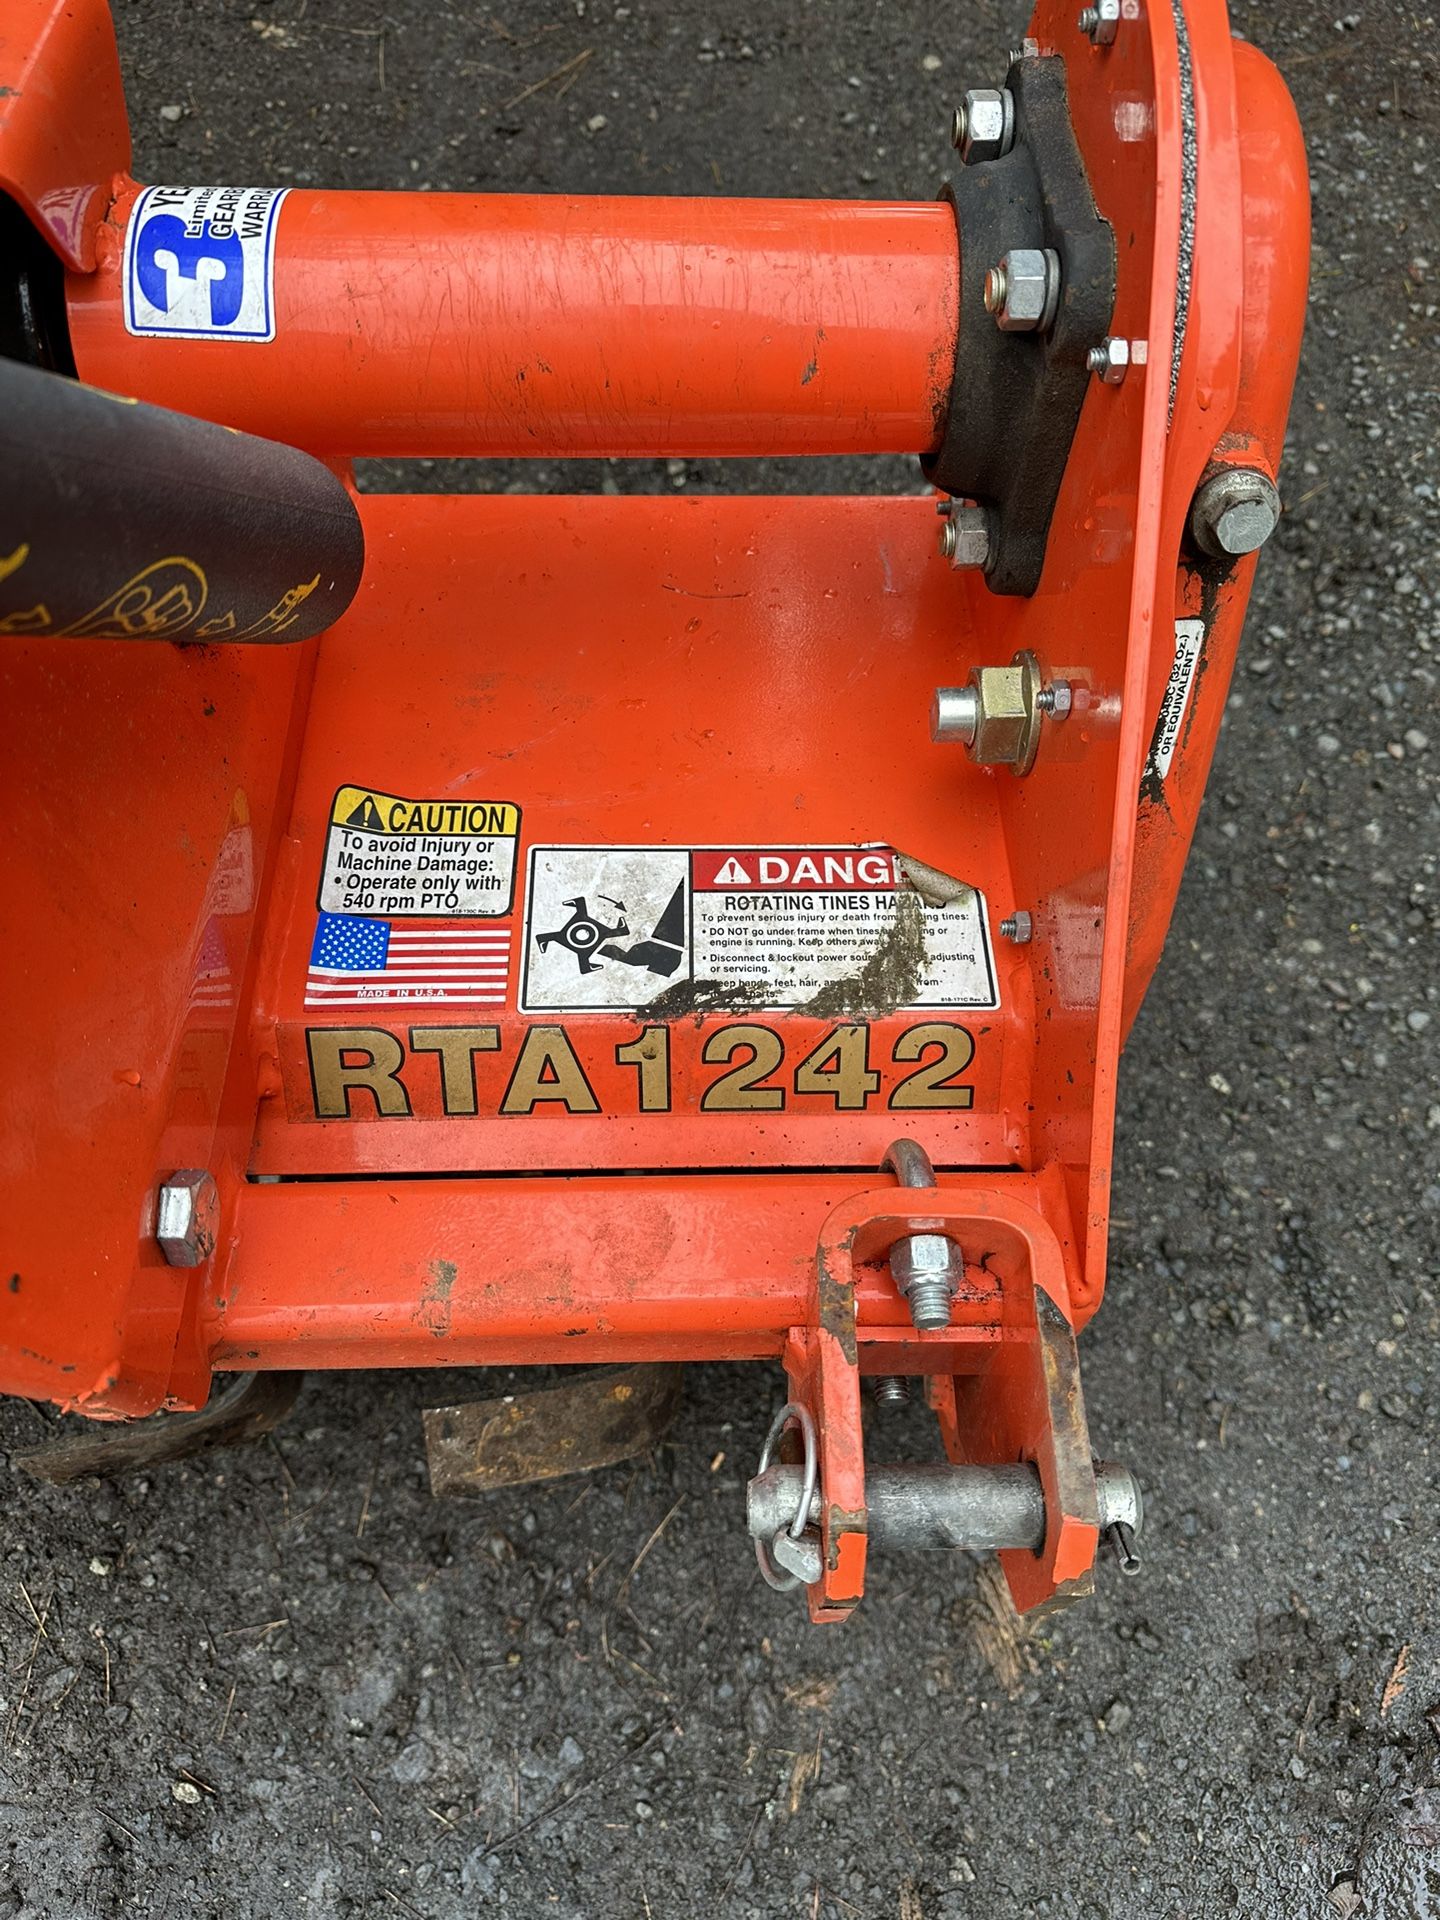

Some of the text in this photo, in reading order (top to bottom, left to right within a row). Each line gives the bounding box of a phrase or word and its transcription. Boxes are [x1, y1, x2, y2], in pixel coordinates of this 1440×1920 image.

[149, 187, 194, 209] YE
[137, 214, 244, 326] 3
[1169, 663, 1182, 683] (32
[1161, 649, 1195, 755] OR EQUIVALENT
[388, 803, 506, 832] CAUTION
[341, 830, 495, 856] To avoid Injury or
[338, 852, 493, 874] Machine Damage:
[759, 856, 907, 884] DANG
[347, 874, 501, 894] Operate only with
[342, 893, 459, 911] 540 rpm PTO
[725, 894, 947, 910] ROTATING TINES HAA
[701, 913, 714, 921] To
[717, 913, 755, 923] prevent
[797, 913, 826, 923] injury
[842, 913, 870, 921] death
[873, 913, 896, 921] from
[942, 913, 970, 921] tines:
[709, 927, 725, 936] DO
[727, 927, 749, 936] NOT
[751, 929, 764, 937] go
[766, 927, 794, 936] under
[797, 927, 825, 936] frame
[828, 927, 854, 936] when
[856, 927, 880, 935] tines
[709, 939, 742, 947] engine
[745, 938, 753, 946] is
[755, 938, 796, 947] running.
[798, 938, 824, 947] Keep
[826, 938, 857, 946] others
[709, 953, 765, 962] Disconnect
[767, 953, 776, 961] &
[777, 953, 814, 961] lockout
[817, 954, 847, 963] power
[930, 952, 975, 962] adjusting
[723, 964, 771, 974] servicing.
[774, 978, 797, 988] feet,
[799, 978, 821, 988] hair,
[356, 989, 448, 998] MADE IN U.S.A.
